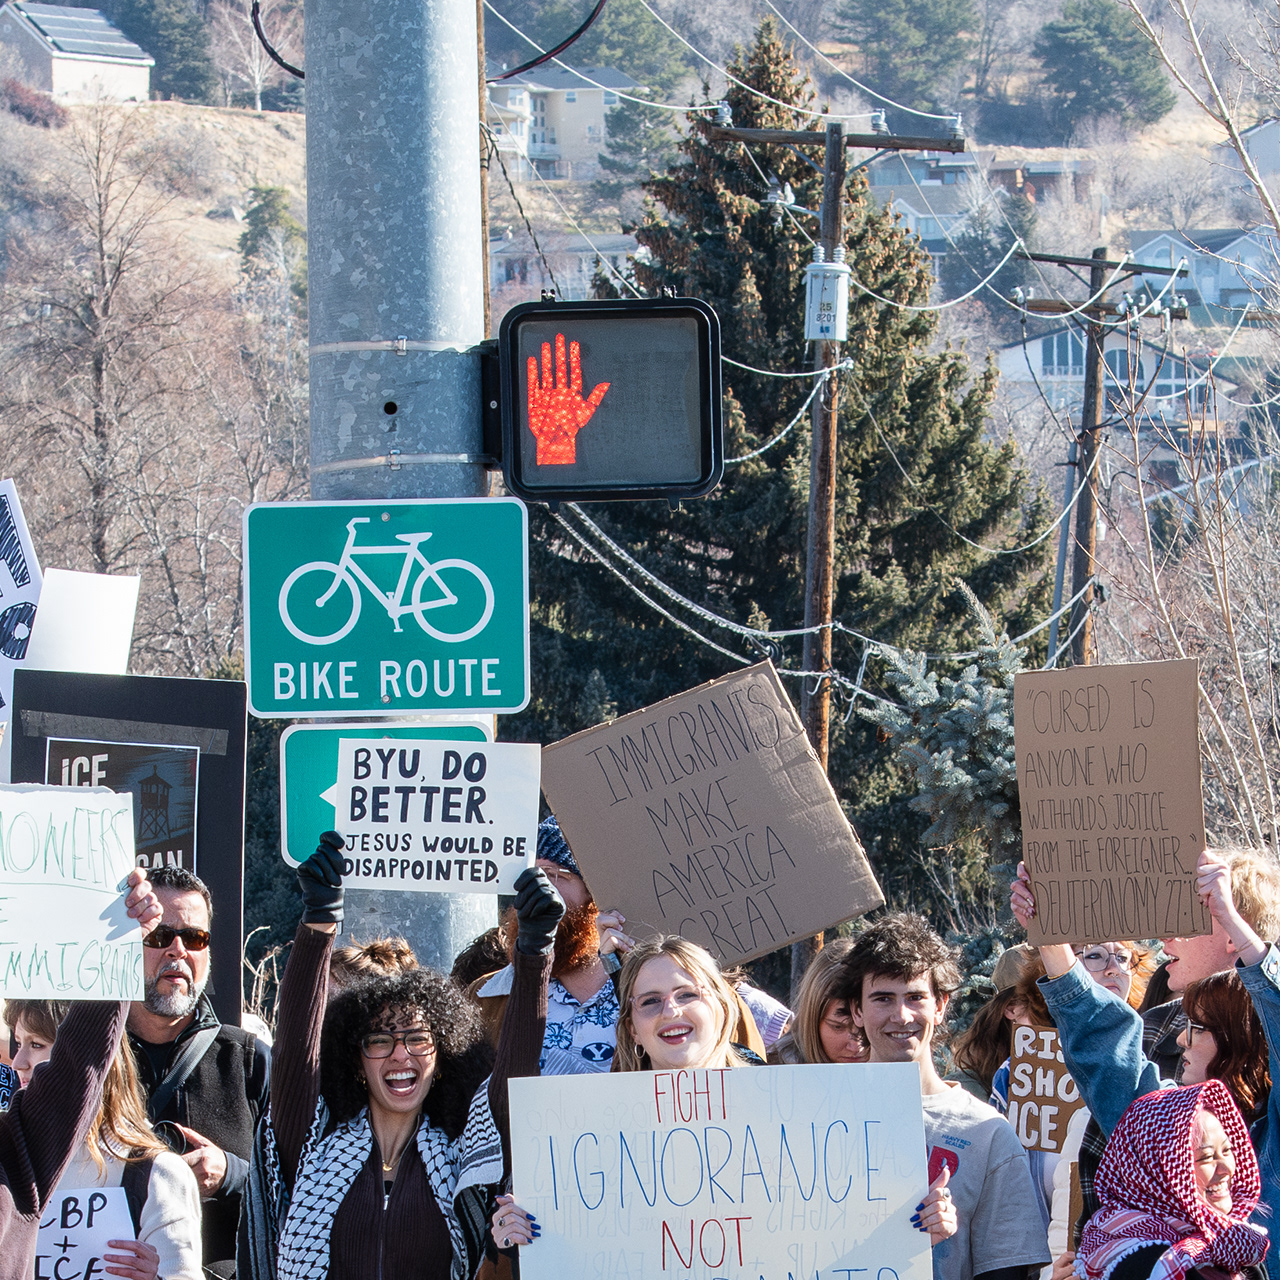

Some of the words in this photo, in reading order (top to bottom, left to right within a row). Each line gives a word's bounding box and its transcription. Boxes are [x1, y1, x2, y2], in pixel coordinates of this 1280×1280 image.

[274, 661, 358, 700] BIKE
[380, 658, 501, 698] ROUTE
[1130, 678, 1155, 730] IS
[353, 747, 426, 782] BYU,
[441, 750, 487, 782] DO
[585, 684, 781, 806] IMMIGRANTS
[1025, 745, 1095, 789] ANYONE
[1102, 742, 1148, 786] WHO
[350, 785, 494, 824] BETTER.
[645, 775, 748, 856] MAKE
[1026, 794, 1108, 832] WITHHOLDS
[1112, 791, 1169, 831] JUSTICE
[345, 833, 412, 852] JESUS
[422, 836, 493, 854] WOULD
[503, 837, 527, 857] BE
[1026, 841, 1059, 875] FROM
[1066, 839, 1092, 873] THE
[343, 858, 500, 884] DISAPPOINTED.
[652, 825, 796, 918] AMERICA
[1034, 876, 1160, 939] DEUTERONOMY
[654, 1068, 732, 1124] FIGHT
[1011, 1062, 1080, 1102] SHO
[1008, 1101, 1058, 1150] ICE
[548, 1119, 888, 1211] IGNORANCE
[39, 1192, 108, 1230] BP
[661, 1217, 752, 1271] NOT
